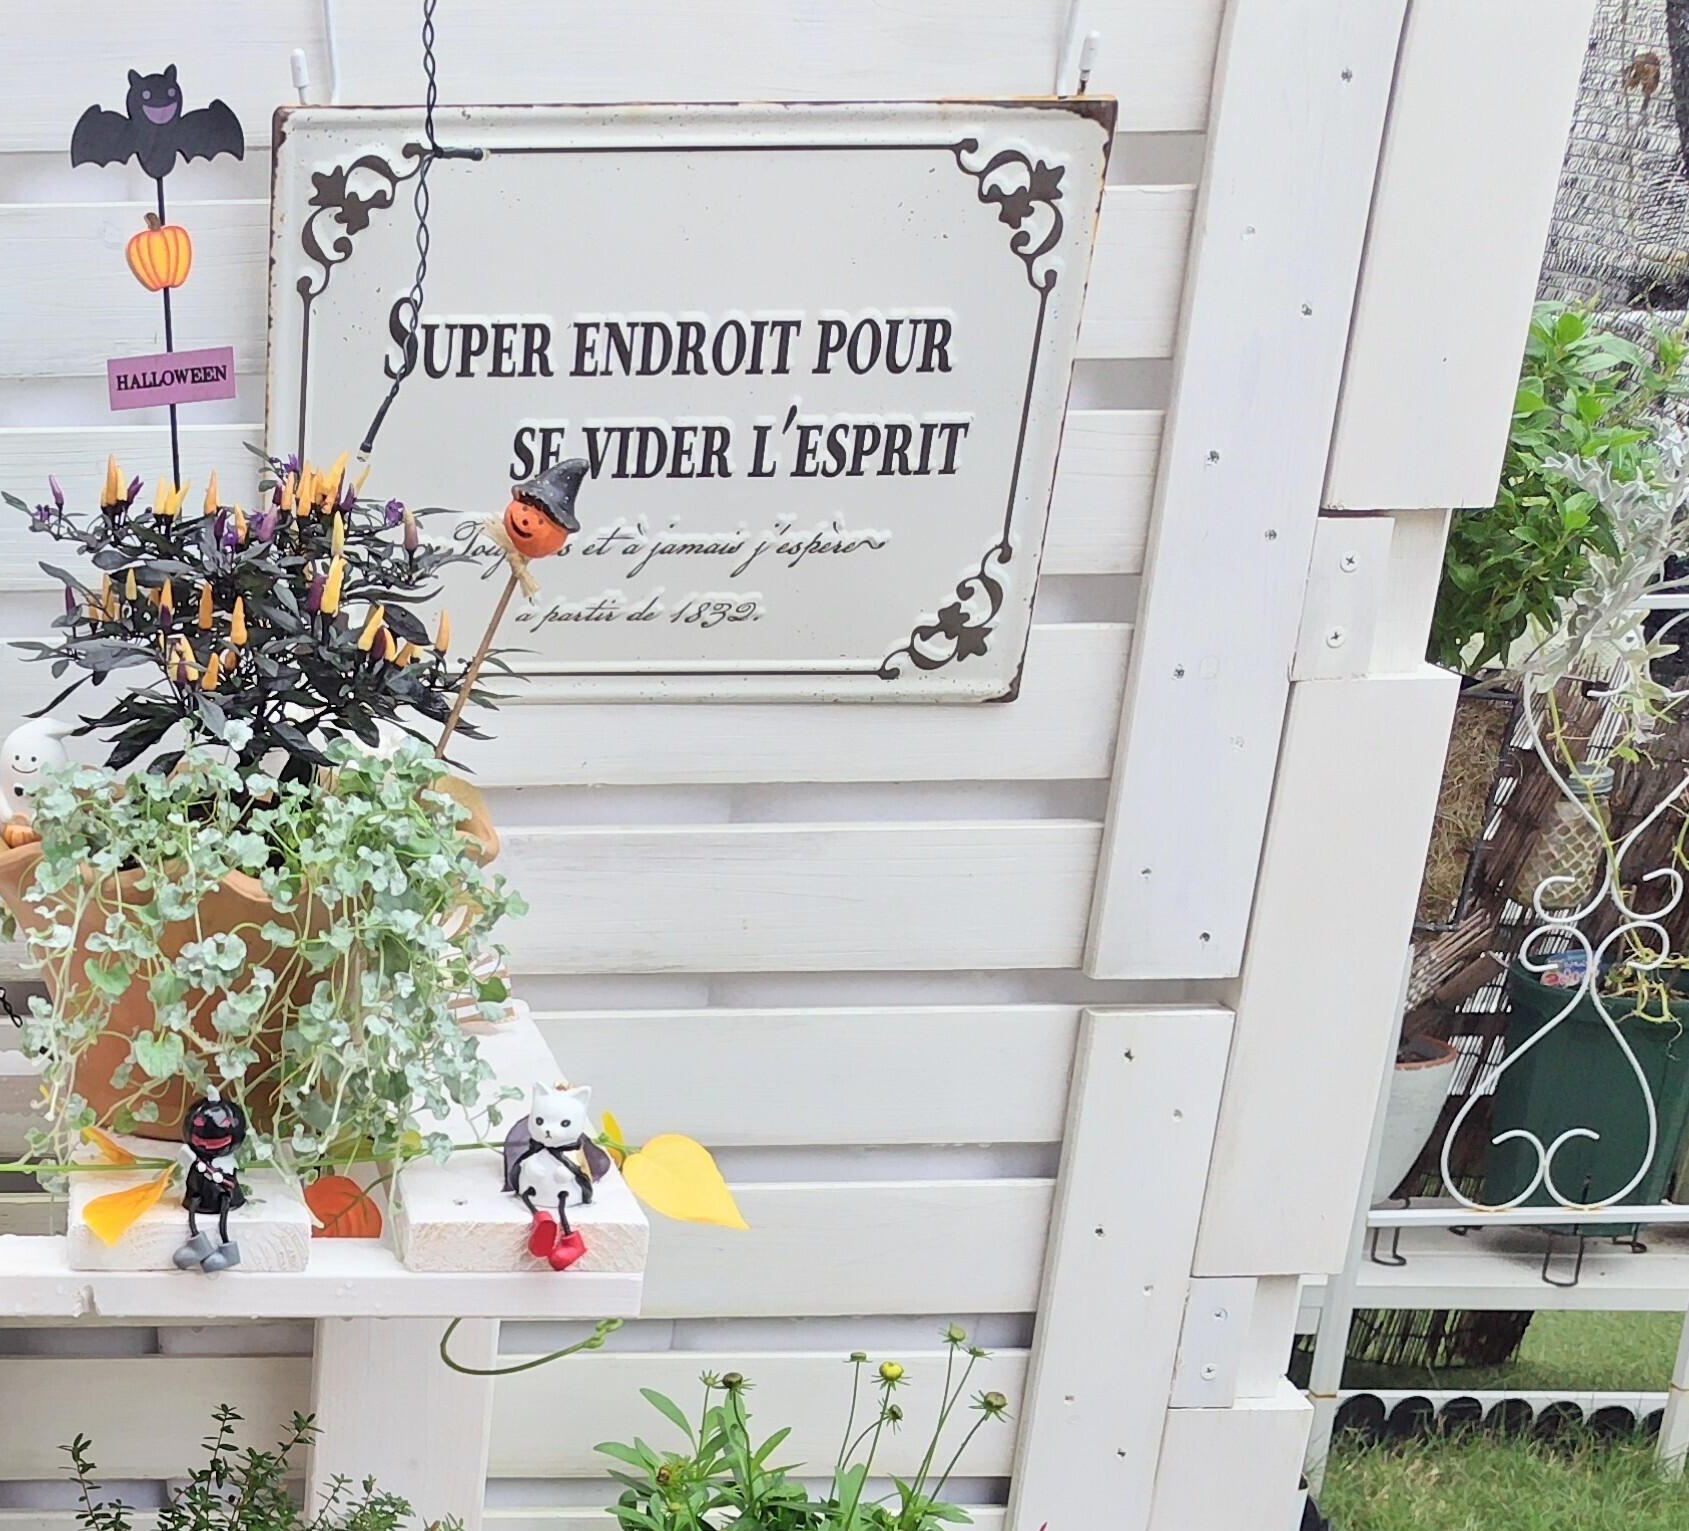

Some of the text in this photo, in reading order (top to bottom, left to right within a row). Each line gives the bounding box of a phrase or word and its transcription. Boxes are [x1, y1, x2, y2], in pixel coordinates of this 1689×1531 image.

[570, 319, 802, 378] ENDROIT
[812, 317, 952, 375] POUR
[116, 364, 227, 391] HALLOWEEN
[510, 404, 970, 480] SE VIDER L'ESPRIT
[582, 527, 635, 556] et
[626, 523, 745, 579] jamais
[530, 599, 621, 633] partir
[626, 596, 660, 622] de
